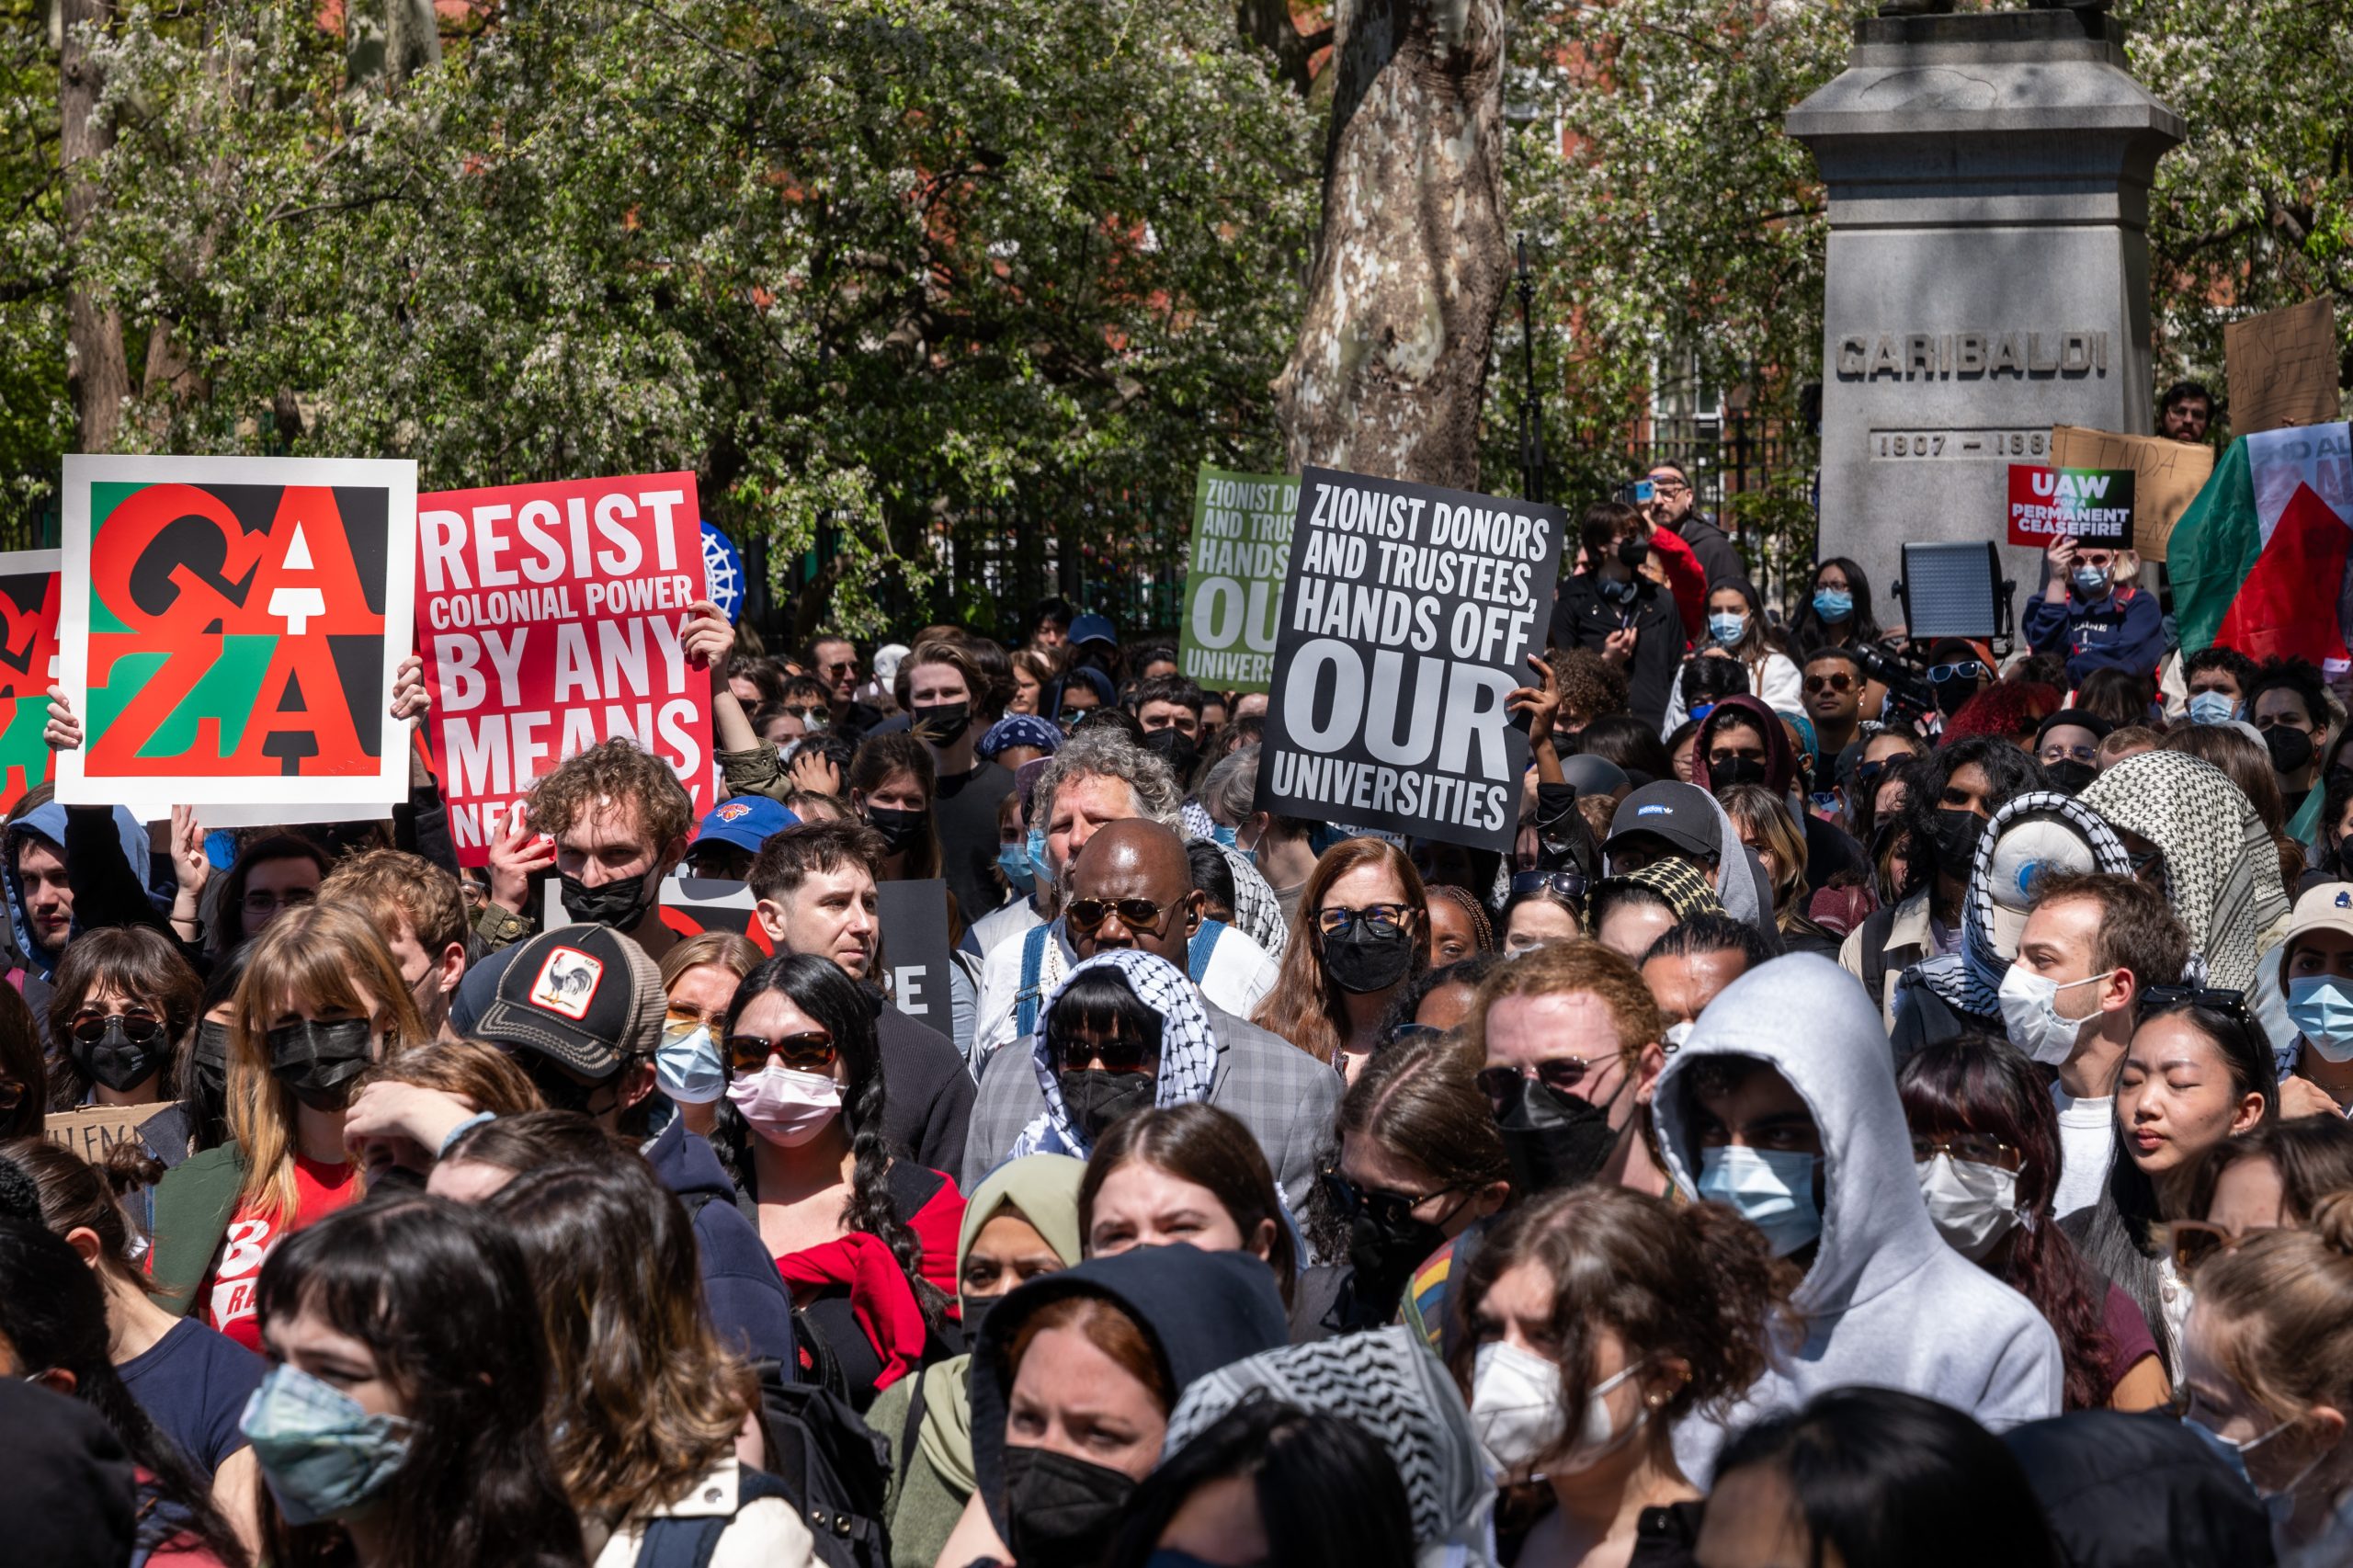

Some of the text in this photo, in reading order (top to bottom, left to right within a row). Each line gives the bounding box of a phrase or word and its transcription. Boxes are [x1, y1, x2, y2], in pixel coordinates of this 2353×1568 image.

[1837, 331, 2108, 379] GARIBALDI
[2235, 306, 2320, 369] FREE
[2230, 344, 2337, 410] PALESTINE
[1881, 433, 1947, 457] 1807
[1997, 433, 2052, 457] 188
[1205, 478, 1279, 512] ZIONIST
[2012, 503, 2131, 523] PERMANENT
[2032, 472, 2110, 499] UAW
[2052, 497, 2086, 508] FOR A
[418, 489, 684, 593] RESIST
[1201, 508, 1244, 539] AND
[1309, 483, 1551, 562] ZIONIST DONORS
[2018, 517, 2122, 537] CEASEFIRE
[1197, 538, 1291, 581] HANDS
[1302, 529, 1538, 615] AND TRUSTEES,
[429, 585, 578, 630] COLONIAL
[585, 574, 694, 617] POWER
[1293, 575, 1536, 666] HANDS OFF
[433, 612, 696, 712] BY ANY
[1283, 638, 1520, 782] OUR
[1271, 749, 1508, 832] UNIVERSITIES
